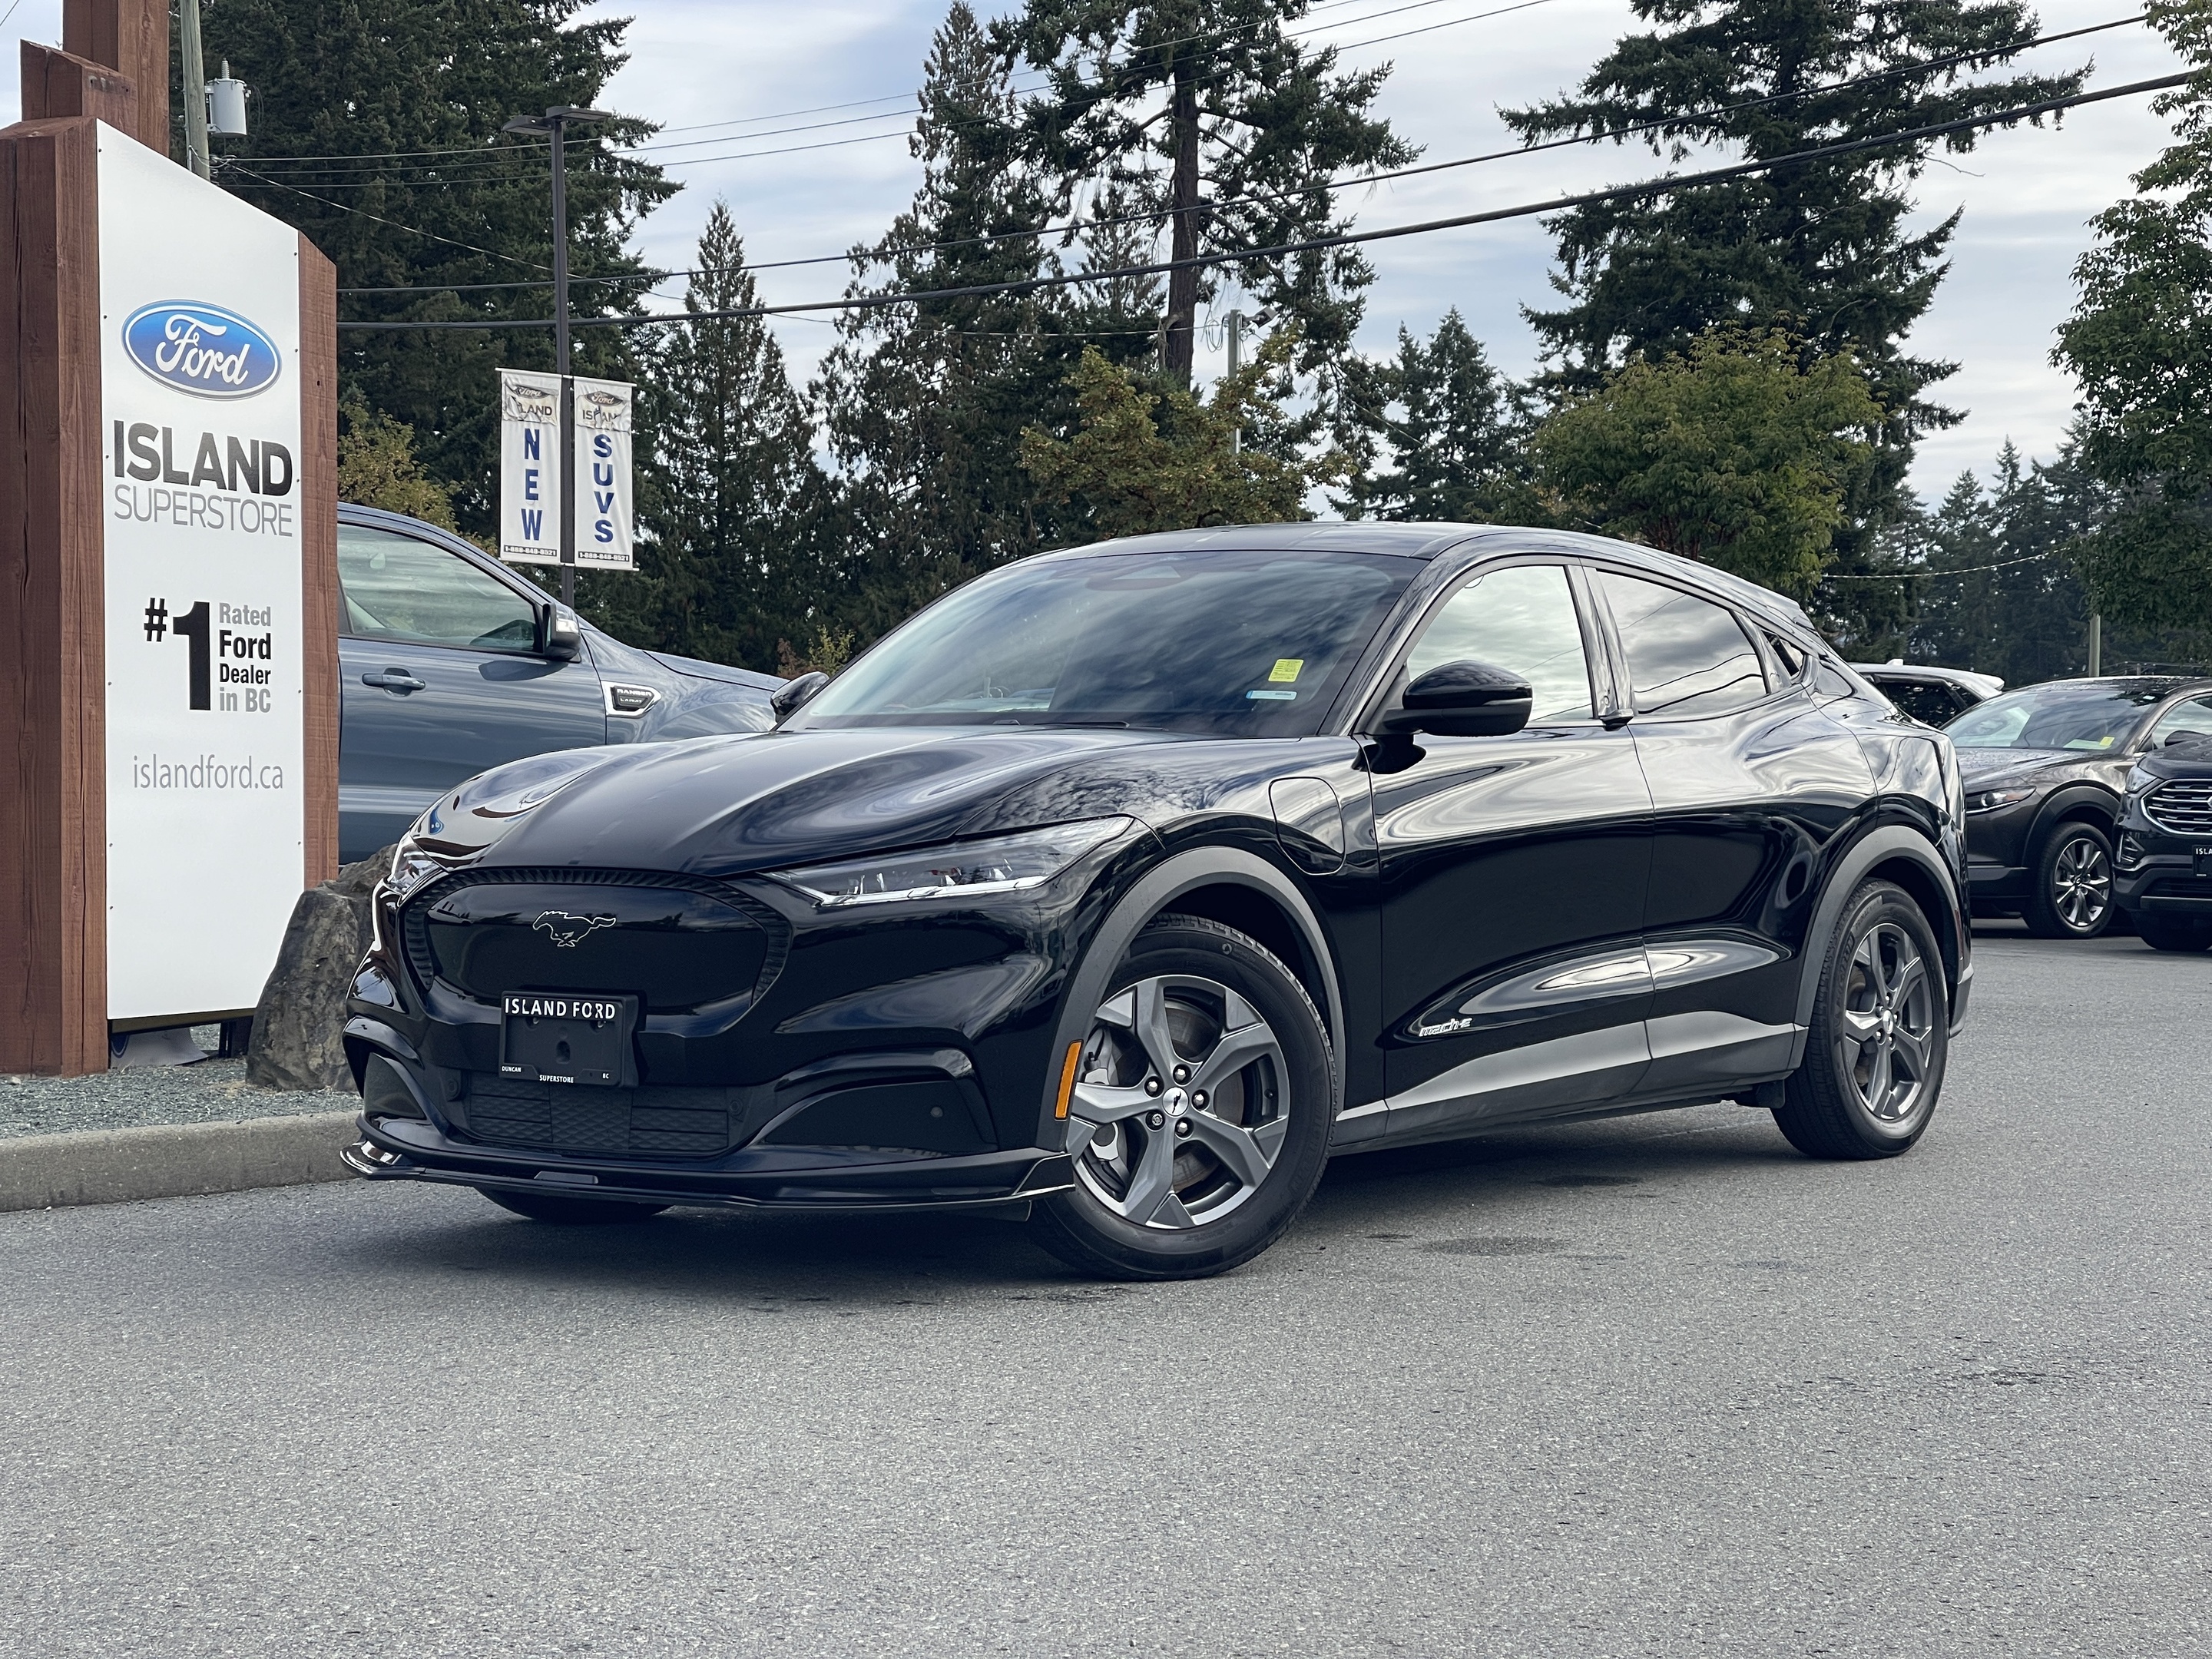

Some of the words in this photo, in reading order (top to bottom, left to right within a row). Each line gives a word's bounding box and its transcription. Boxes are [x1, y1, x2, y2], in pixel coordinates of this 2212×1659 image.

[156, 314, 250, 385] Ford
[591, 392, 614, 404] Ford
[114, 419, 293, 496] ISLAND
[521, 428, 543, 541] NEW
[593, 433, 614, 543] SUVS
[114, 484, 293, 537] SUPERSTORE
[219, 602, 271, 627] Rated
[144, 598, 211, 710] #1
[219, 629, 271, 660] Ford
[219, 663, 271, 684] Dealer
[219, 687, 238, 711] in
[245, 687, 271, 713] BC
[617, 688, 652, 697] RANGER
[134, 753, 283, 789] islandford.ca
[505, 998, 567, 1016] ISLAND
[572, 1002, 615, 1019] FORD
[539, 1075, 574, 1083] SUPERSTORE
